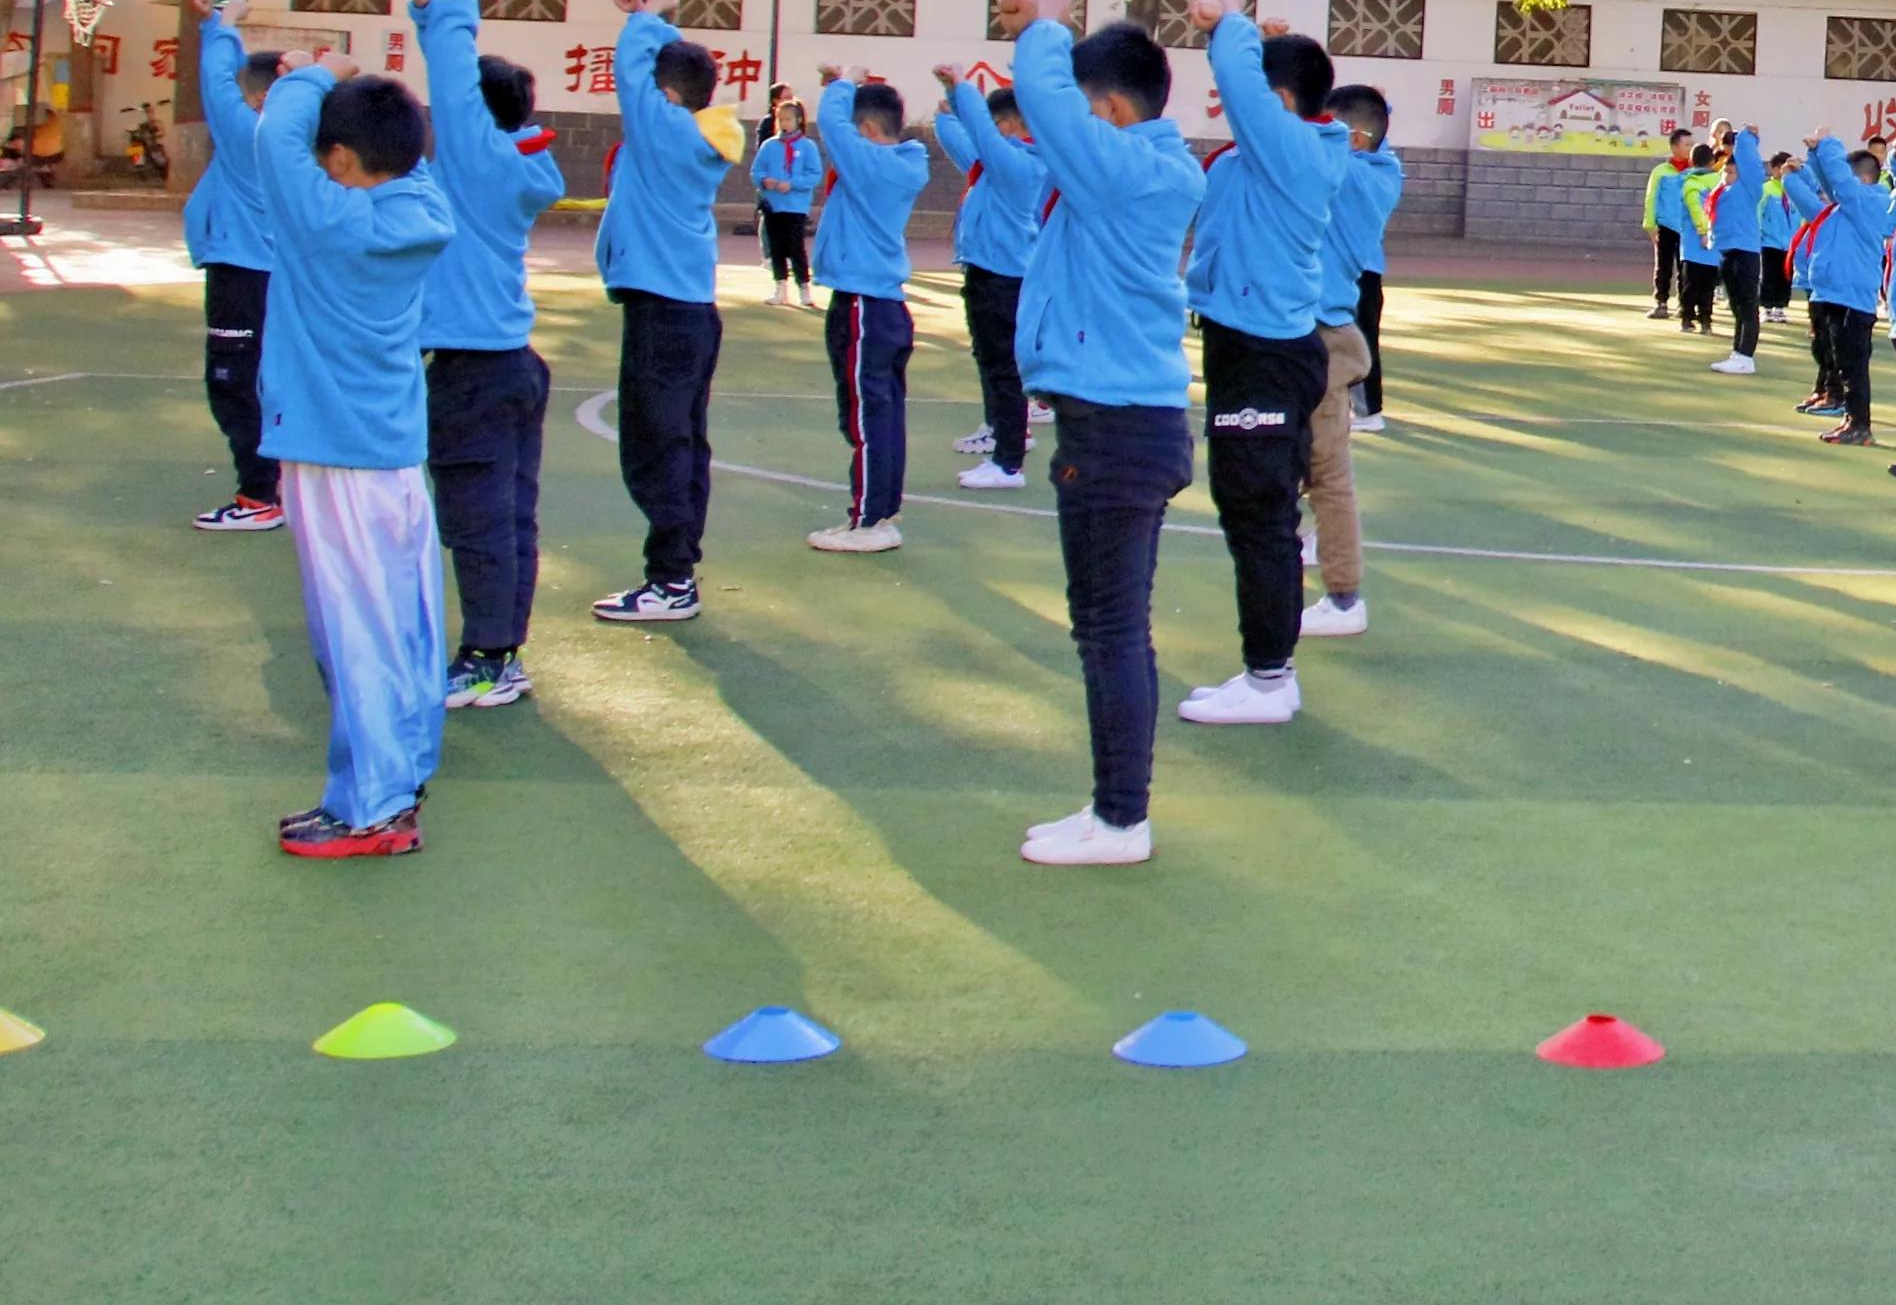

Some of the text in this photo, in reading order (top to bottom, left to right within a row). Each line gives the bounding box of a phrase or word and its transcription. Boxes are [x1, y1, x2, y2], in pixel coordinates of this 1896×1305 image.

[1568, 102, 1596, 113] Toilet
[1477, 111, 1495, 130] 出
[1660, 119, 1677, 136] 进
